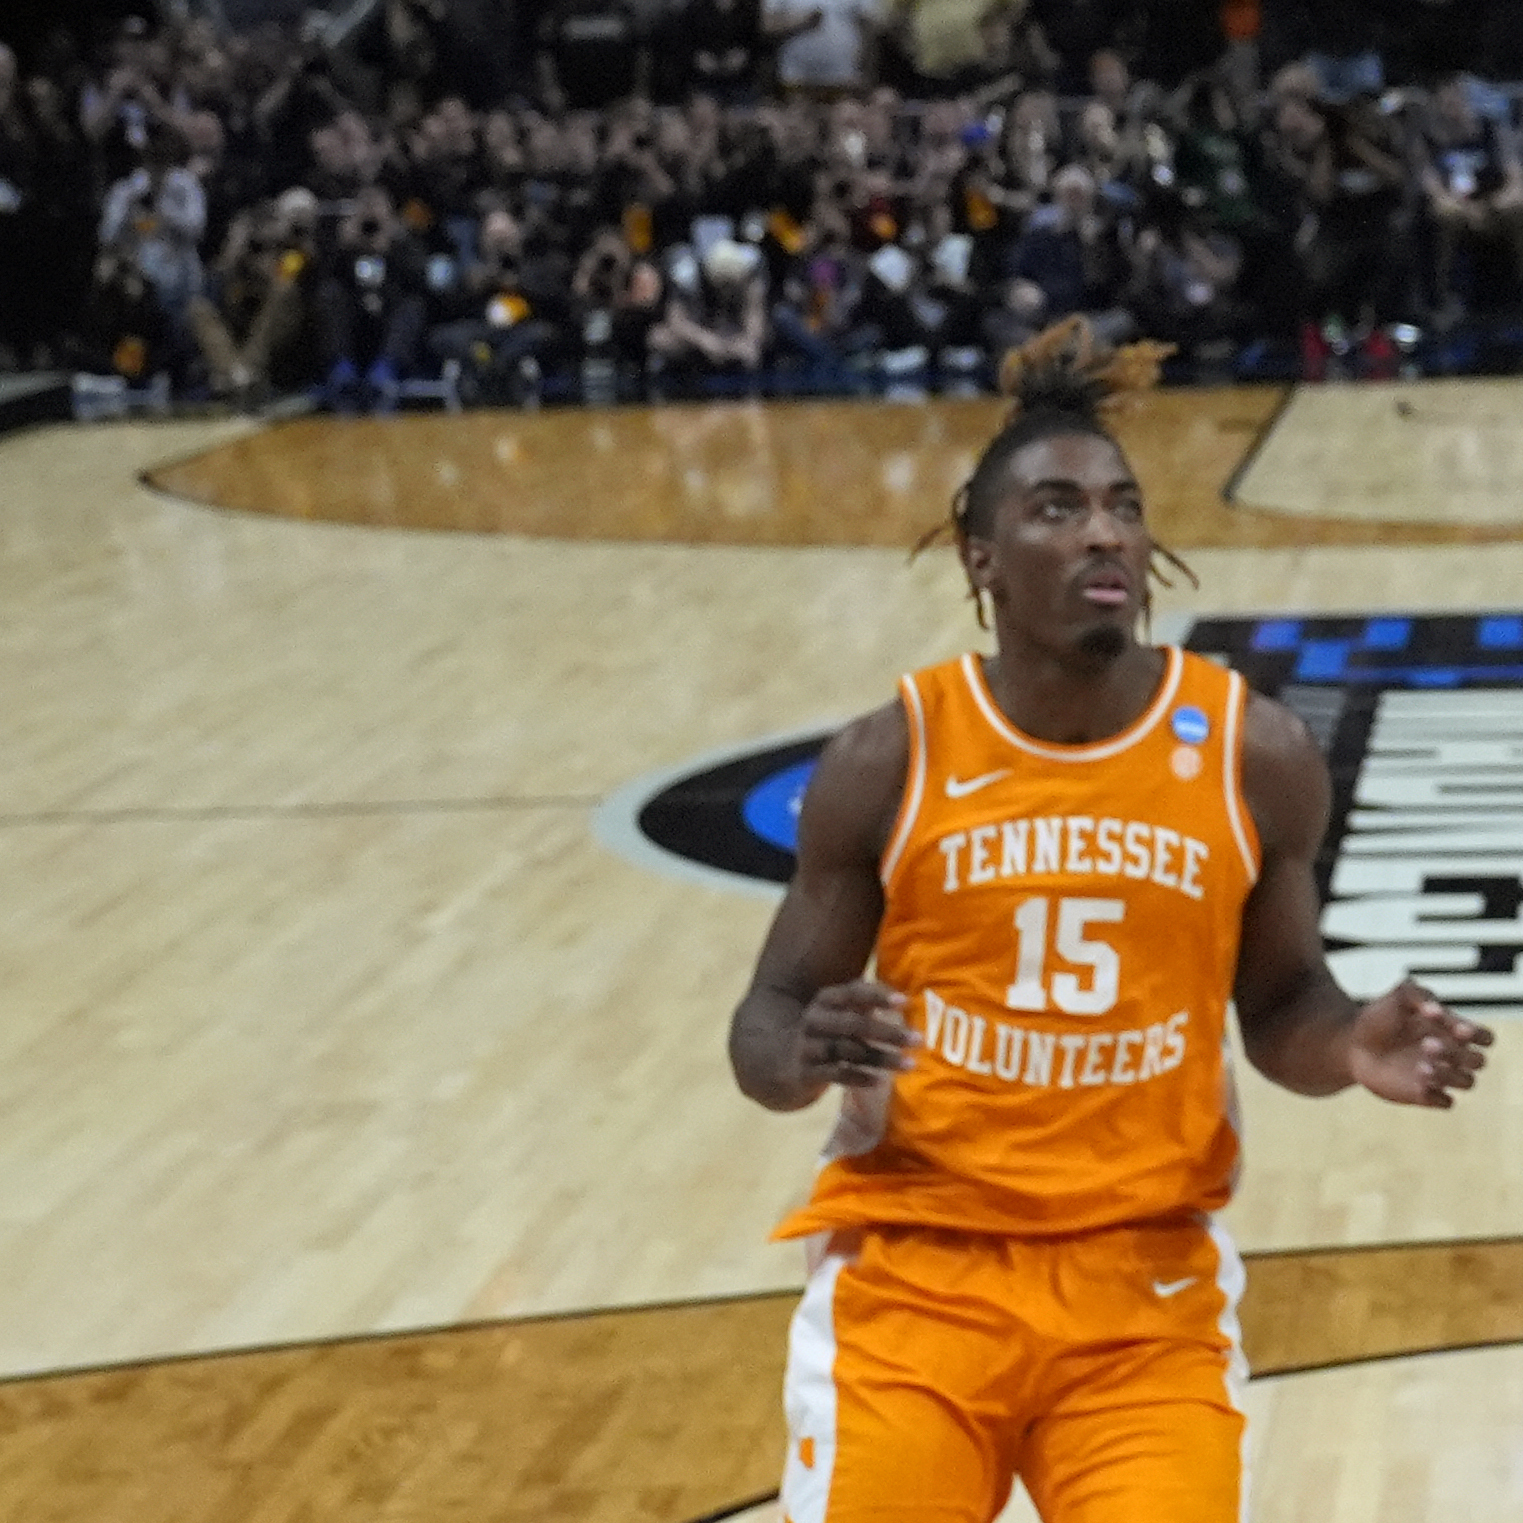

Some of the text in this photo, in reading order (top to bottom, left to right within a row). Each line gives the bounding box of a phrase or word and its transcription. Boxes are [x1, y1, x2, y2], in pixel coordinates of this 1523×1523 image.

[939, 815, 1210, 900] TENNESSEE
[1005, 895, 1127, 1017] 15
[922, 987, 1191, 1091] VOLUNTEERS
